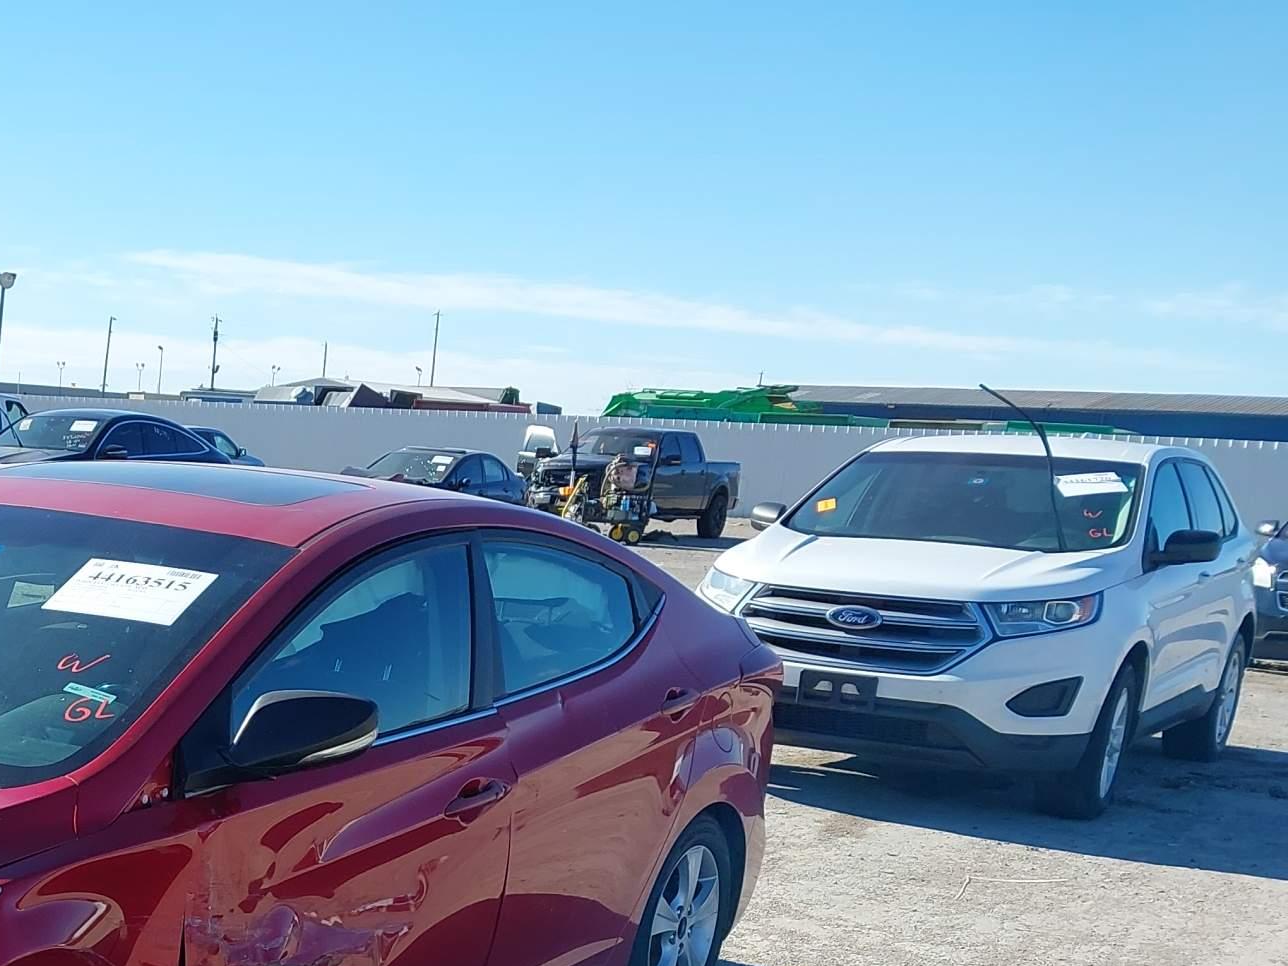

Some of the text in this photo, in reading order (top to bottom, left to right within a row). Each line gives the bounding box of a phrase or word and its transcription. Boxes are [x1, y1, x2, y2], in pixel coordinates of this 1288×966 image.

[1088, 527, 1114, 539] GL
[88, 571, 192, 592] 44163515
[838, 608, 869, 624] Ford
[64, 697, 116, 722] GL
